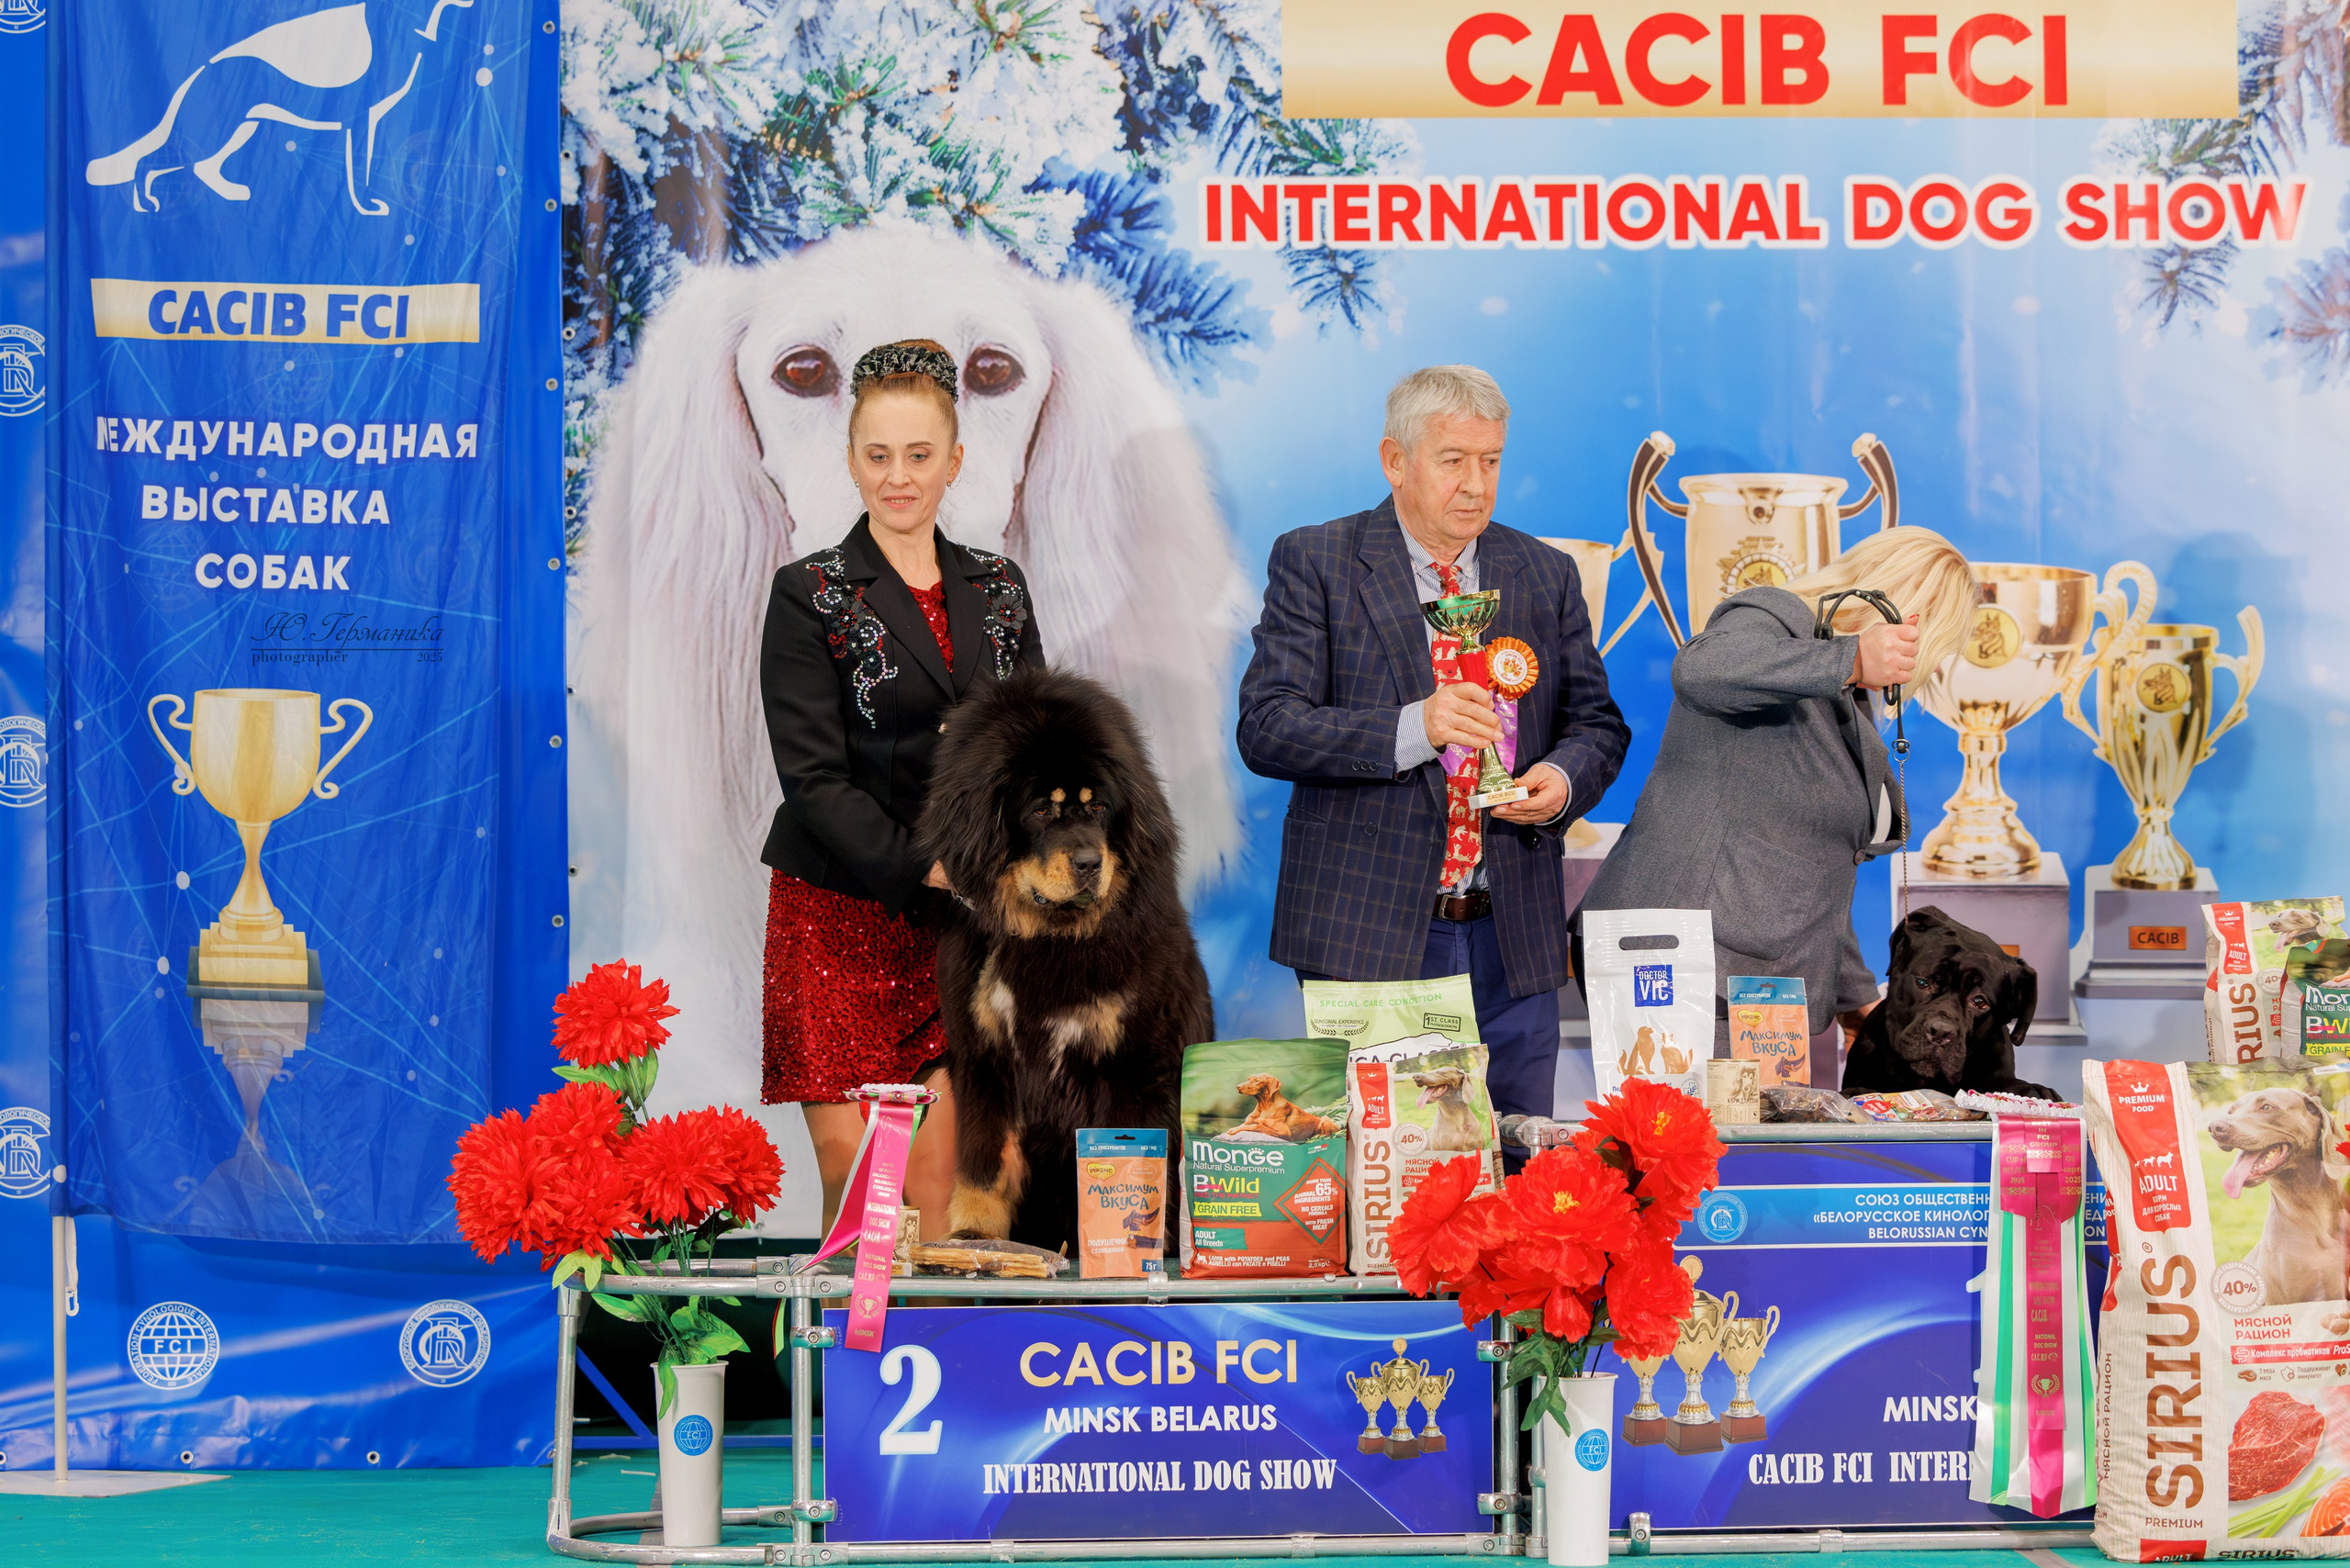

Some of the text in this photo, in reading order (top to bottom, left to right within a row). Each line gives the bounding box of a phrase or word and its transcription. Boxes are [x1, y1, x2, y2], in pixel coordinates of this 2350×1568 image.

[1446, 13, 2068, 108] CACIB FCI
[1204, 182, 2307, 243] INTERNATIONAL DOG SHOW
[148, 289, 410, 339] CACIB FCI
[141, 485, 390, 525] ВЫСТАВКА
[195, 552, 352, 591] СОБАК
[2137, 932, 2180, 945] CACIB
[2228, 950, 2247, 960] ADULT
[1639, 970, 1668, 980] DOCTOR
[1639, 979, 1669, 1001] VIC
[1388, 993, 1442, 1006] CONDITION
[2305, 1003, 2335, 1012] Natural
[2229, 983, 2265, 1064] RIUS
[2310, 1046, 2342, 1054] GRAIN
[2119, 1094, 2165, 1104] PREMIUM
[1368, 1103, 1384, 1114] ADULT
[1400, 1134, 1423, 1144] 40%
[1193, 1161, 1285, 1174] Natural Superpremium
[1193, 1174, 1259, 1193] BWild
[1315, 1182, 1337, 1196] 65%
[2139, 1175, 2177, 1193] ADULT
[1294, 1196, 1331, 1204] INGREDIENTS
[1364, 1140, 1392, 1259] SIRIUS
[1855, 1193, 1900, 1206] СОЮЗ
[2153, 1194, 2167, 1203] КОРМ
[1198, 1204, 1258, 1215] GRAIN FREE
[2142, 1204, 2181, 1215] ДЛЯ ВЗРОСЛЫХ
[1813, 1210, 1920, 1223] «БЕЛОРУССКОЕ
[1195, 1230, 1216, 1238] ADULT
[1869, 1226, 1955, 1238] BELORUSSIAN
[1088, 1238, 1126, 1247] ПОДУШЕЧКИ
[1146, 1261, 1153, 1271] 75
[2222, 1280, 2257, 1295] 40%
[2233, 1314, 2292, 1327] МЯСНОЙ
[2235, 1328, 2290, 1340] РАЦИОН
[130, 1305, 217, 1384] FEDERATION CYNOLOGIQUE INTERNATIONALE
[154, 1339, 191, 1354] FCI
[2251, 1349, 2286, 1359] Комплекс
[2287, 1348, 2330, 1358] пробиотиков
[1020, 1338, 1299, 1388] CACIB FCI
[2297, 1365, 2331, 1373] Поддерживает
[2141, 1253, 2204, 1509] SIRIUS
[878, 1343, 944, 1456] 2
[1883, 1394, 1977, 1422] MINSK
[1043, 1403, 1278, 1435] MINSK BELARUS
[2102, 1353, 2112, 1479] МЯСНОЙ РАЦИОН
[1748, 1451, 1825, 1485] CACIB
[1833, 1450, 1874, 1483] FCI
[983, 1458, 1337, 1495] INTERNATIONAL DOG SHOW
[2145, 1517, 2203, 1529] PREMIUM
